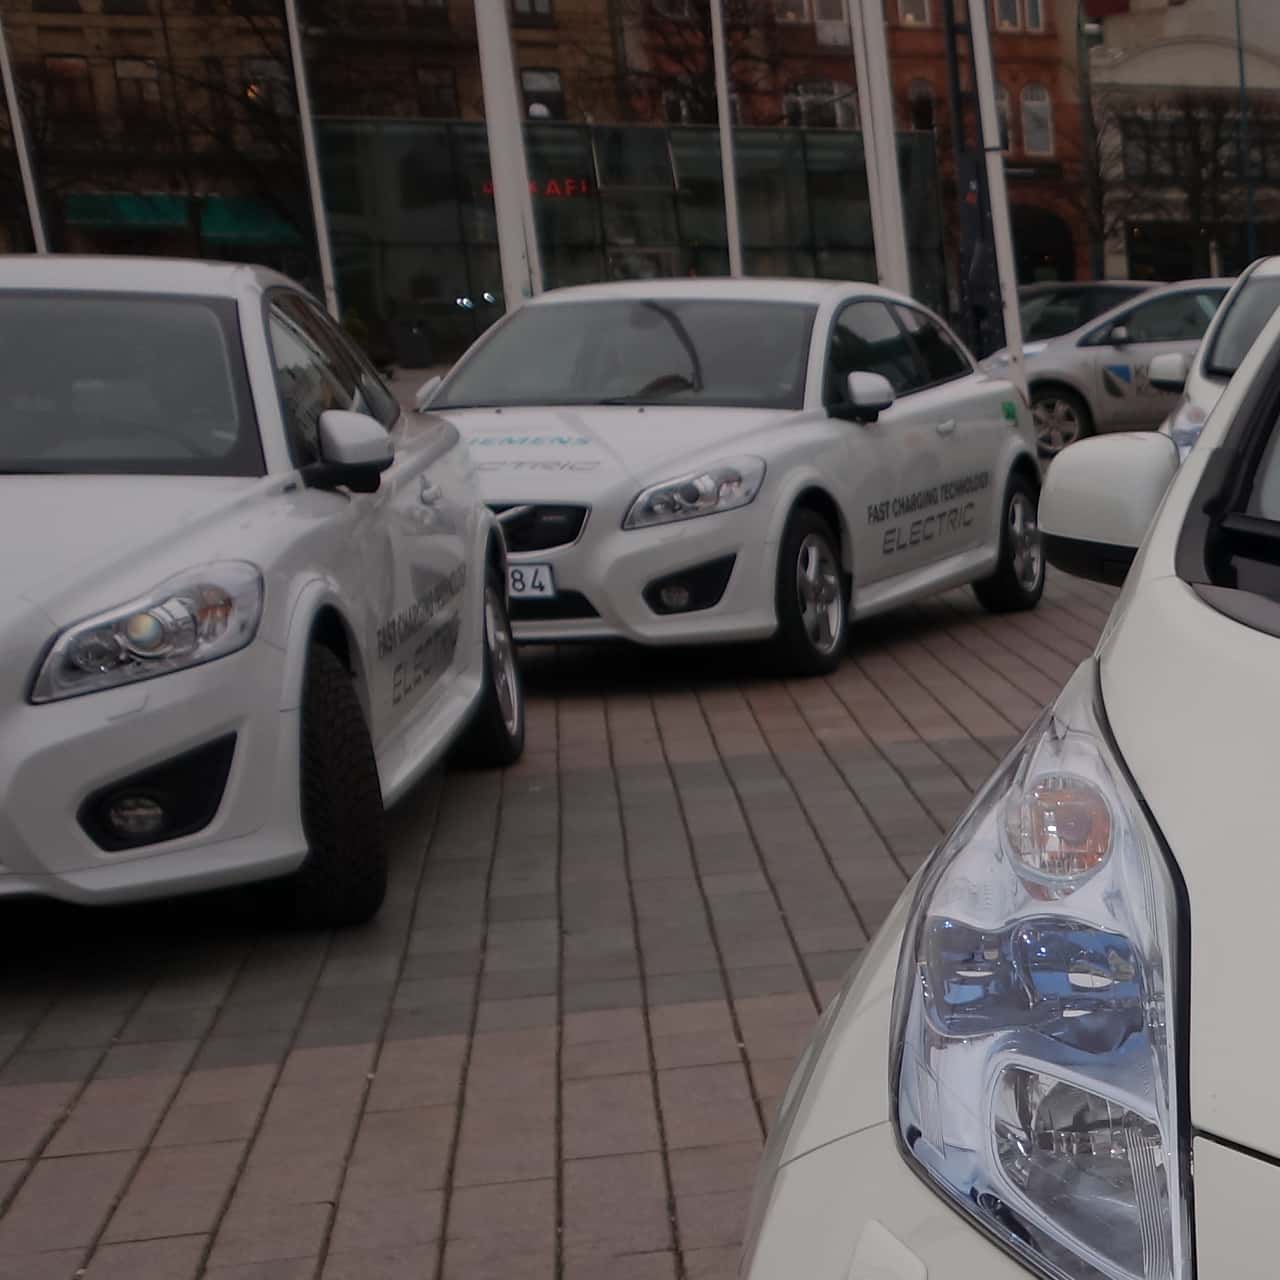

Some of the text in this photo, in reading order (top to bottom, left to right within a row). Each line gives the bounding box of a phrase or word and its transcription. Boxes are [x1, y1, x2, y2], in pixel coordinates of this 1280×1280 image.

[468, 435, 593, 447] IEMENS
[475, 460, 601, 472] CTRIC
[866, 500, 891, 526] FAST
[892, 486, 939, 518] CHARGING
[881, 501, 976, 555] ELECTRIC
[510, 567, 545, 592] 84
